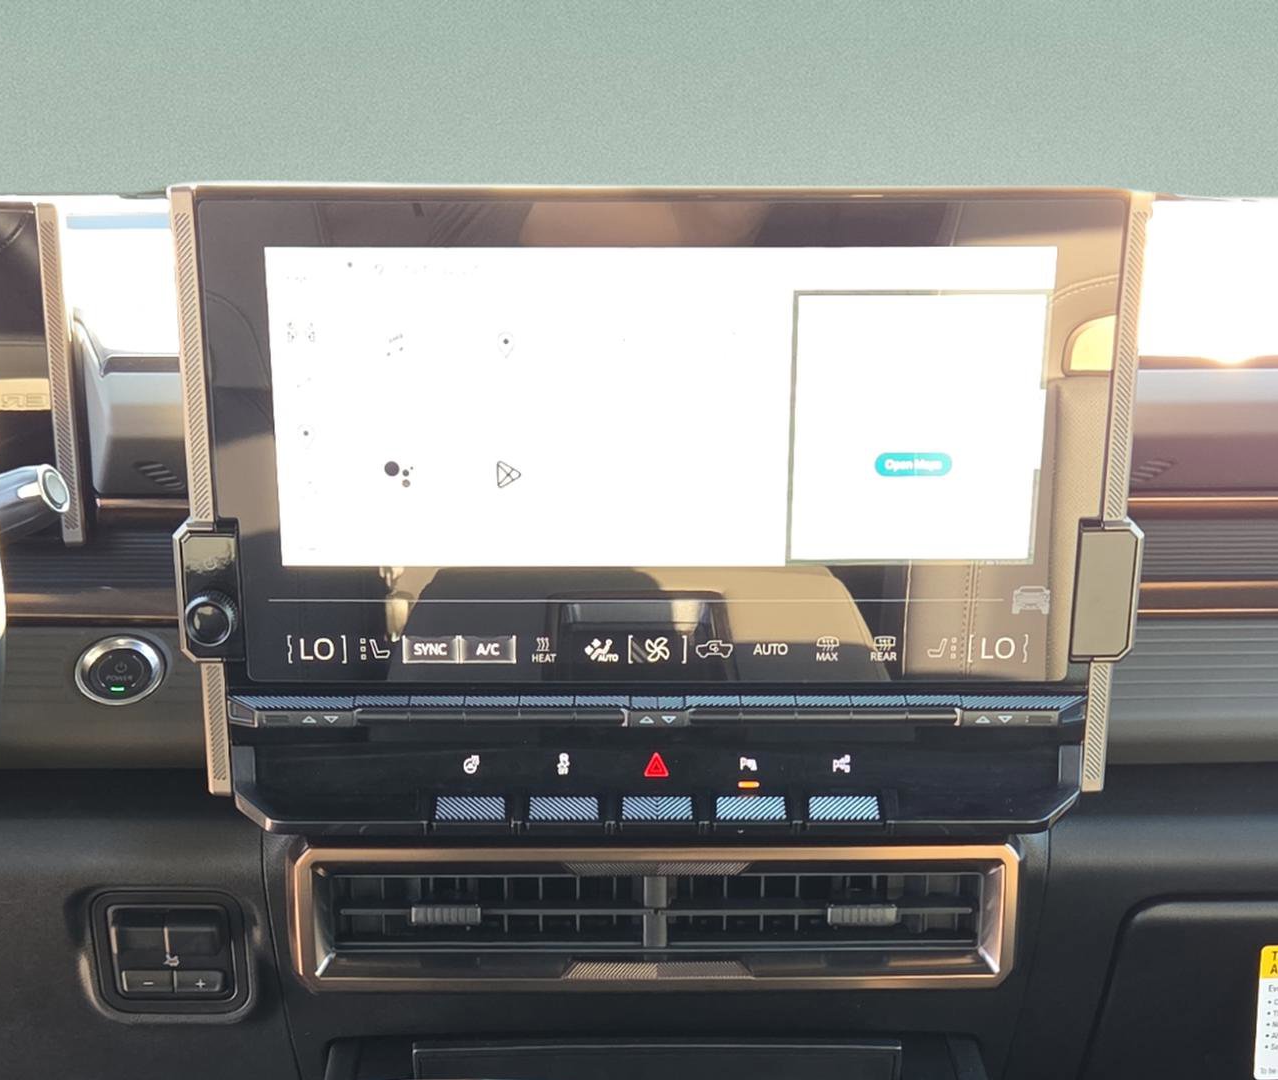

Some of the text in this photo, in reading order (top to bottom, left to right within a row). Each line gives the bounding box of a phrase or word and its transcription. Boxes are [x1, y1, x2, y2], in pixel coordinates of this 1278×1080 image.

[299, 638, 335, 660] LO
[413, 643, 447, 656] SYNC
[476, 643, 500, 657] A/C
[753, 644, 788, 656] AUTO
[980, 637, 1015, 660] LO
[532, 654, 556, 663] HEAT
[598, 654, 619, 663] AUTO
[816, 652, 838, 662] MAX
[870, 652, 897, 662] REAR
